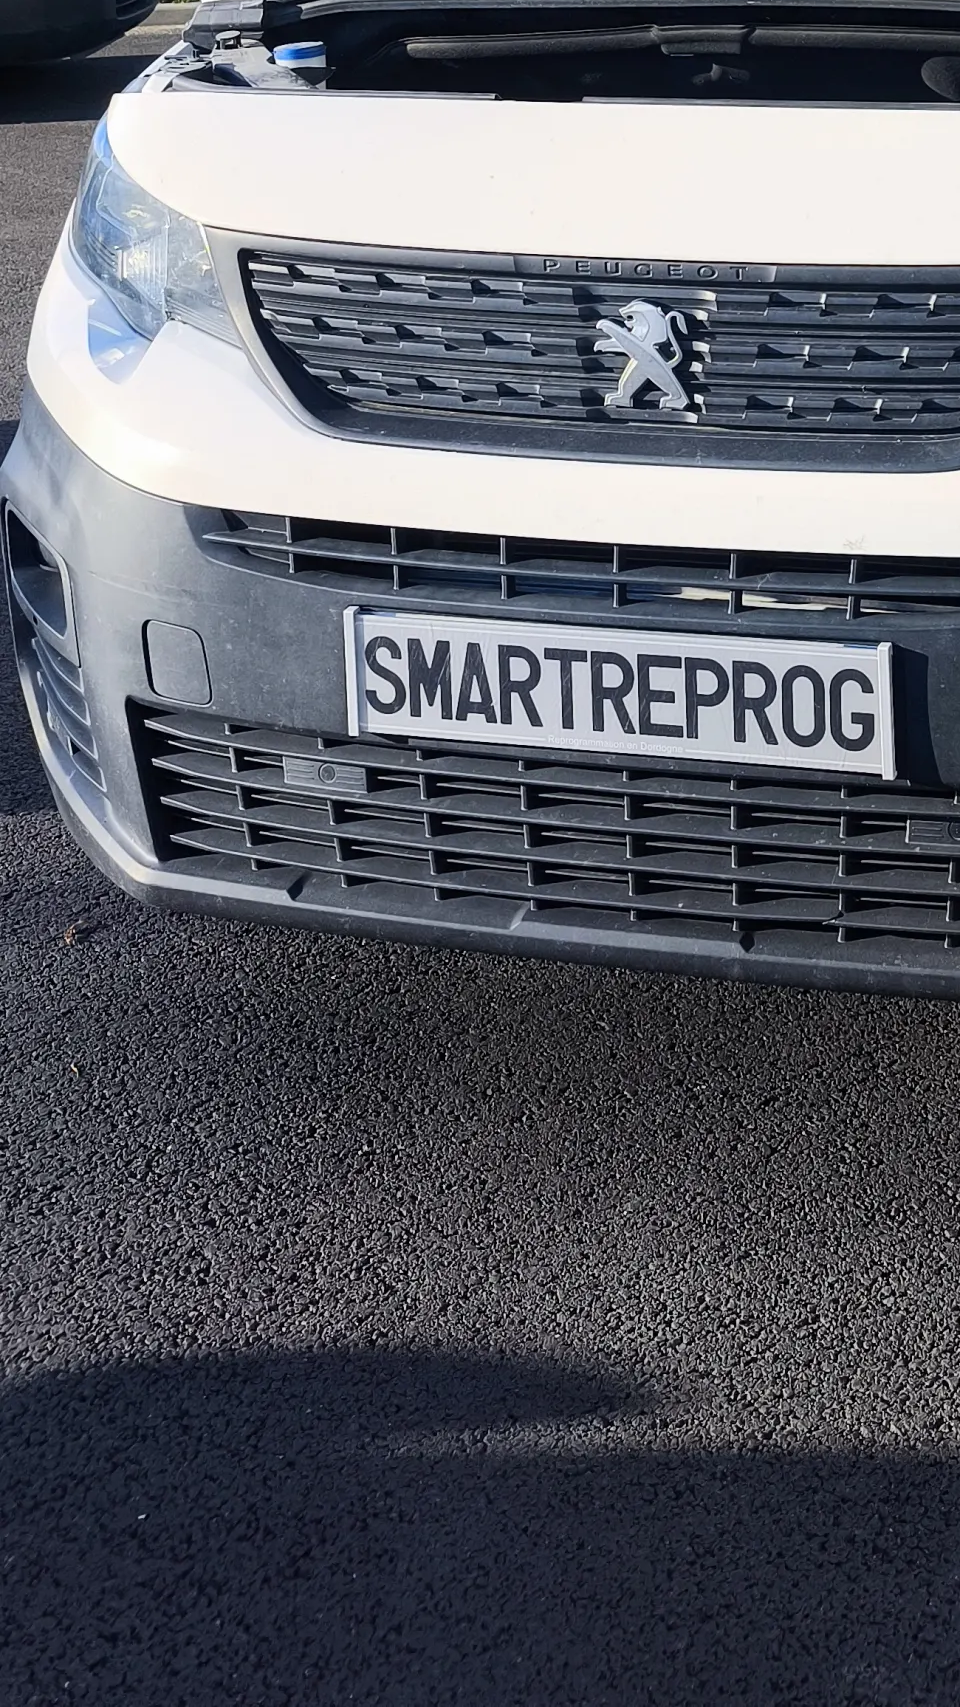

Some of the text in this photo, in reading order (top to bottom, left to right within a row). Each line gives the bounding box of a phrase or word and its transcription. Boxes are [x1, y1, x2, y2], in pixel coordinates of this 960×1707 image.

[543, 258, 750, 281] PEUGEOT
[364, 635, 876, 752] SMARTREPROG
[640, 741, 684, 754] Dordogne
